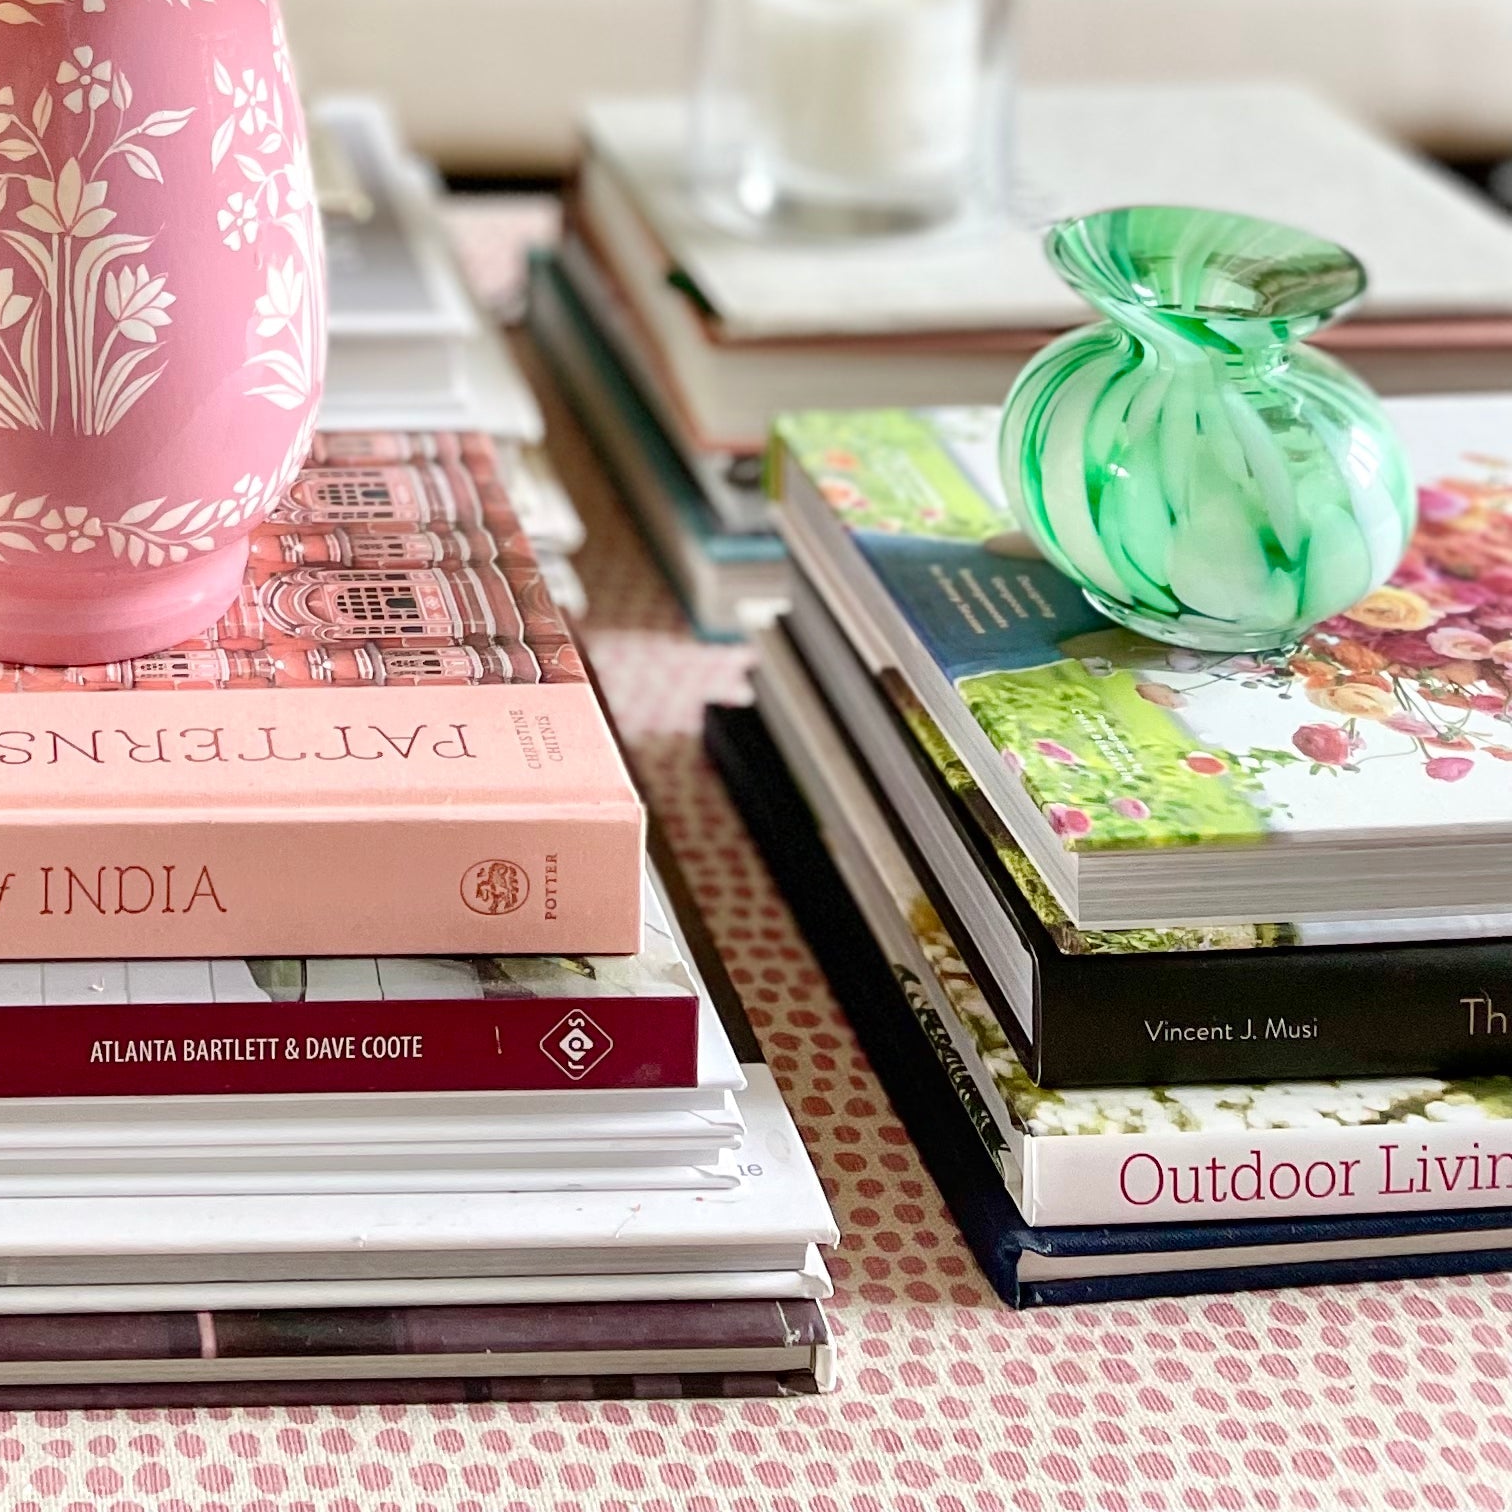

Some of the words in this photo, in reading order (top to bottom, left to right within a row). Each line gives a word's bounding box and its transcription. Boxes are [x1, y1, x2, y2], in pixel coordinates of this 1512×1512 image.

[509, 709, 542, 769] CHRISTINE
[534, 715, 564, 762] CHITNIS
[39, 864, 227, 916] INDIA
[544, 852, 558, 921] POTTER
[89, 1039, 177, 1064] ATLANTA
[183, 1037, 280, 1063] BARTLETT
[284, 1038, 300, 1060] &
[305, 1035, 356, 1060] DAVE
[361, 1035, 424, 1059] COOTE
[1144, 1019, 1234, 1042] Vincent
[1239, 1018, 1257, 1041] J.
[1264, 1017, 1319, 1040] Musi
[1119, 1150, 1361, 1206] Outdoor
